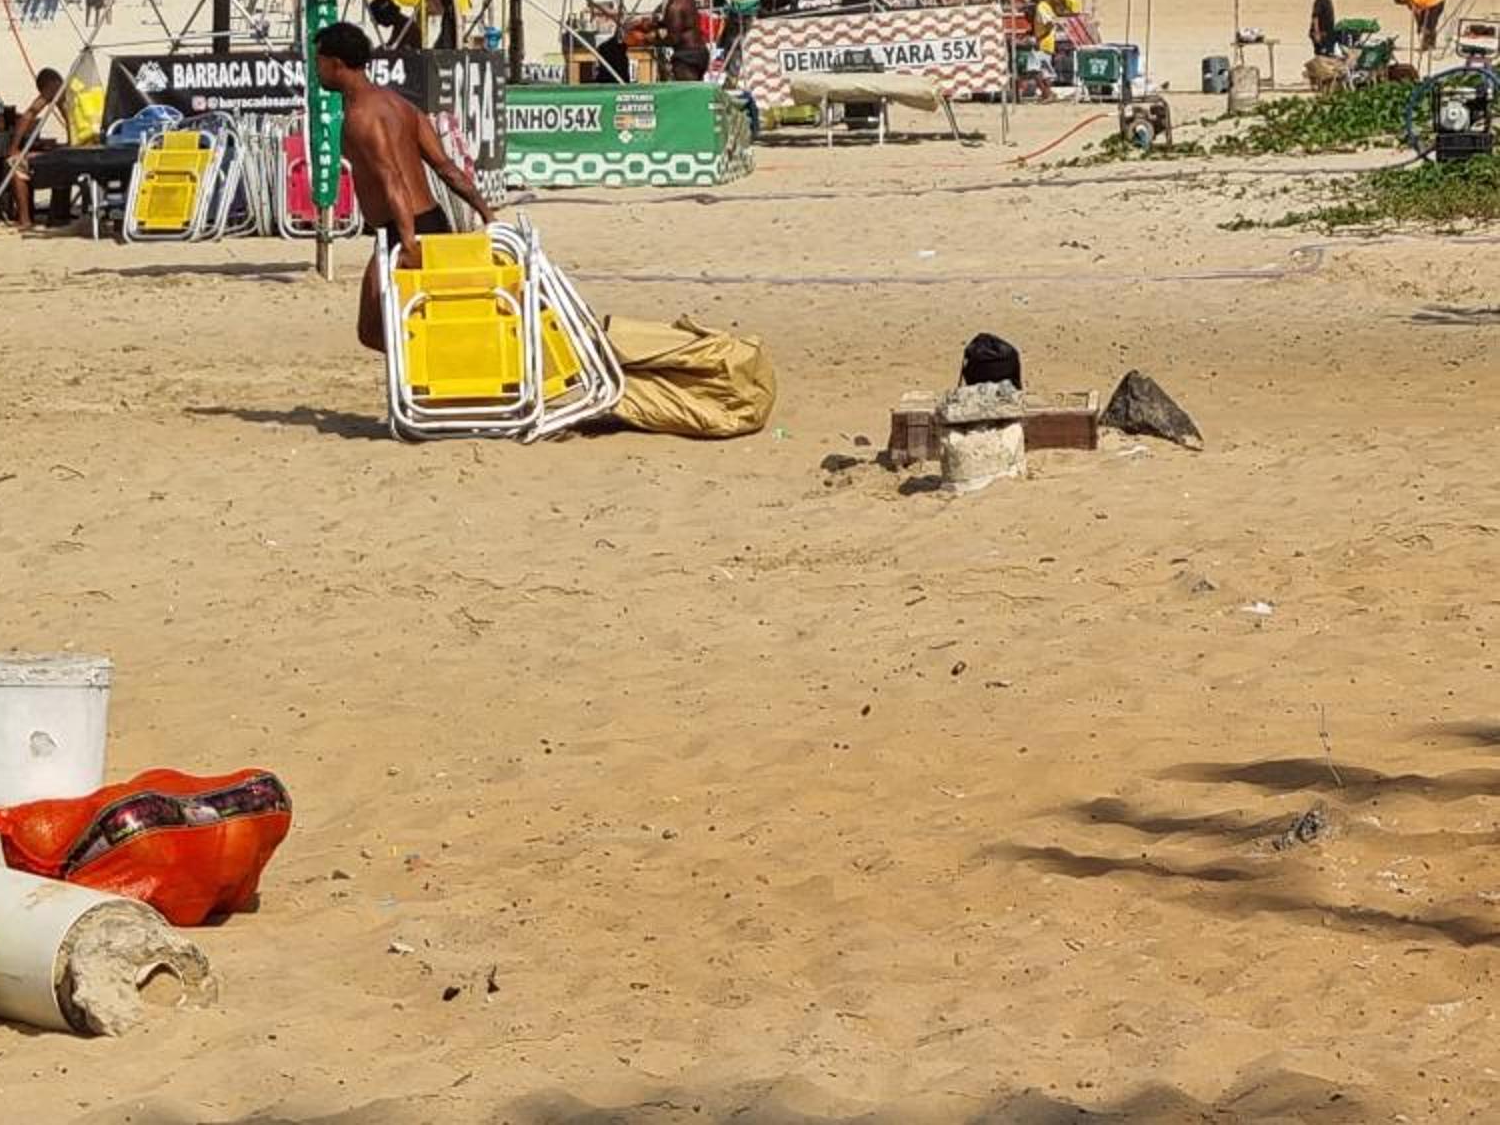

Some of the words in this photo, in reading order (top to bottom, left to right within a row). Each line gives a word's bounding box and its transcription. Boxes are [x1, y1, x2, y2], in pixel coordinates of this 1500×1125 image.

[883, 43, 935, 65] YARA
[941, 39, 978, 61] 55X
[172, 60, 253, 89] BARRACA
[255, 61, 281, 87] DO
[561, 106, 599, 130] 54X
